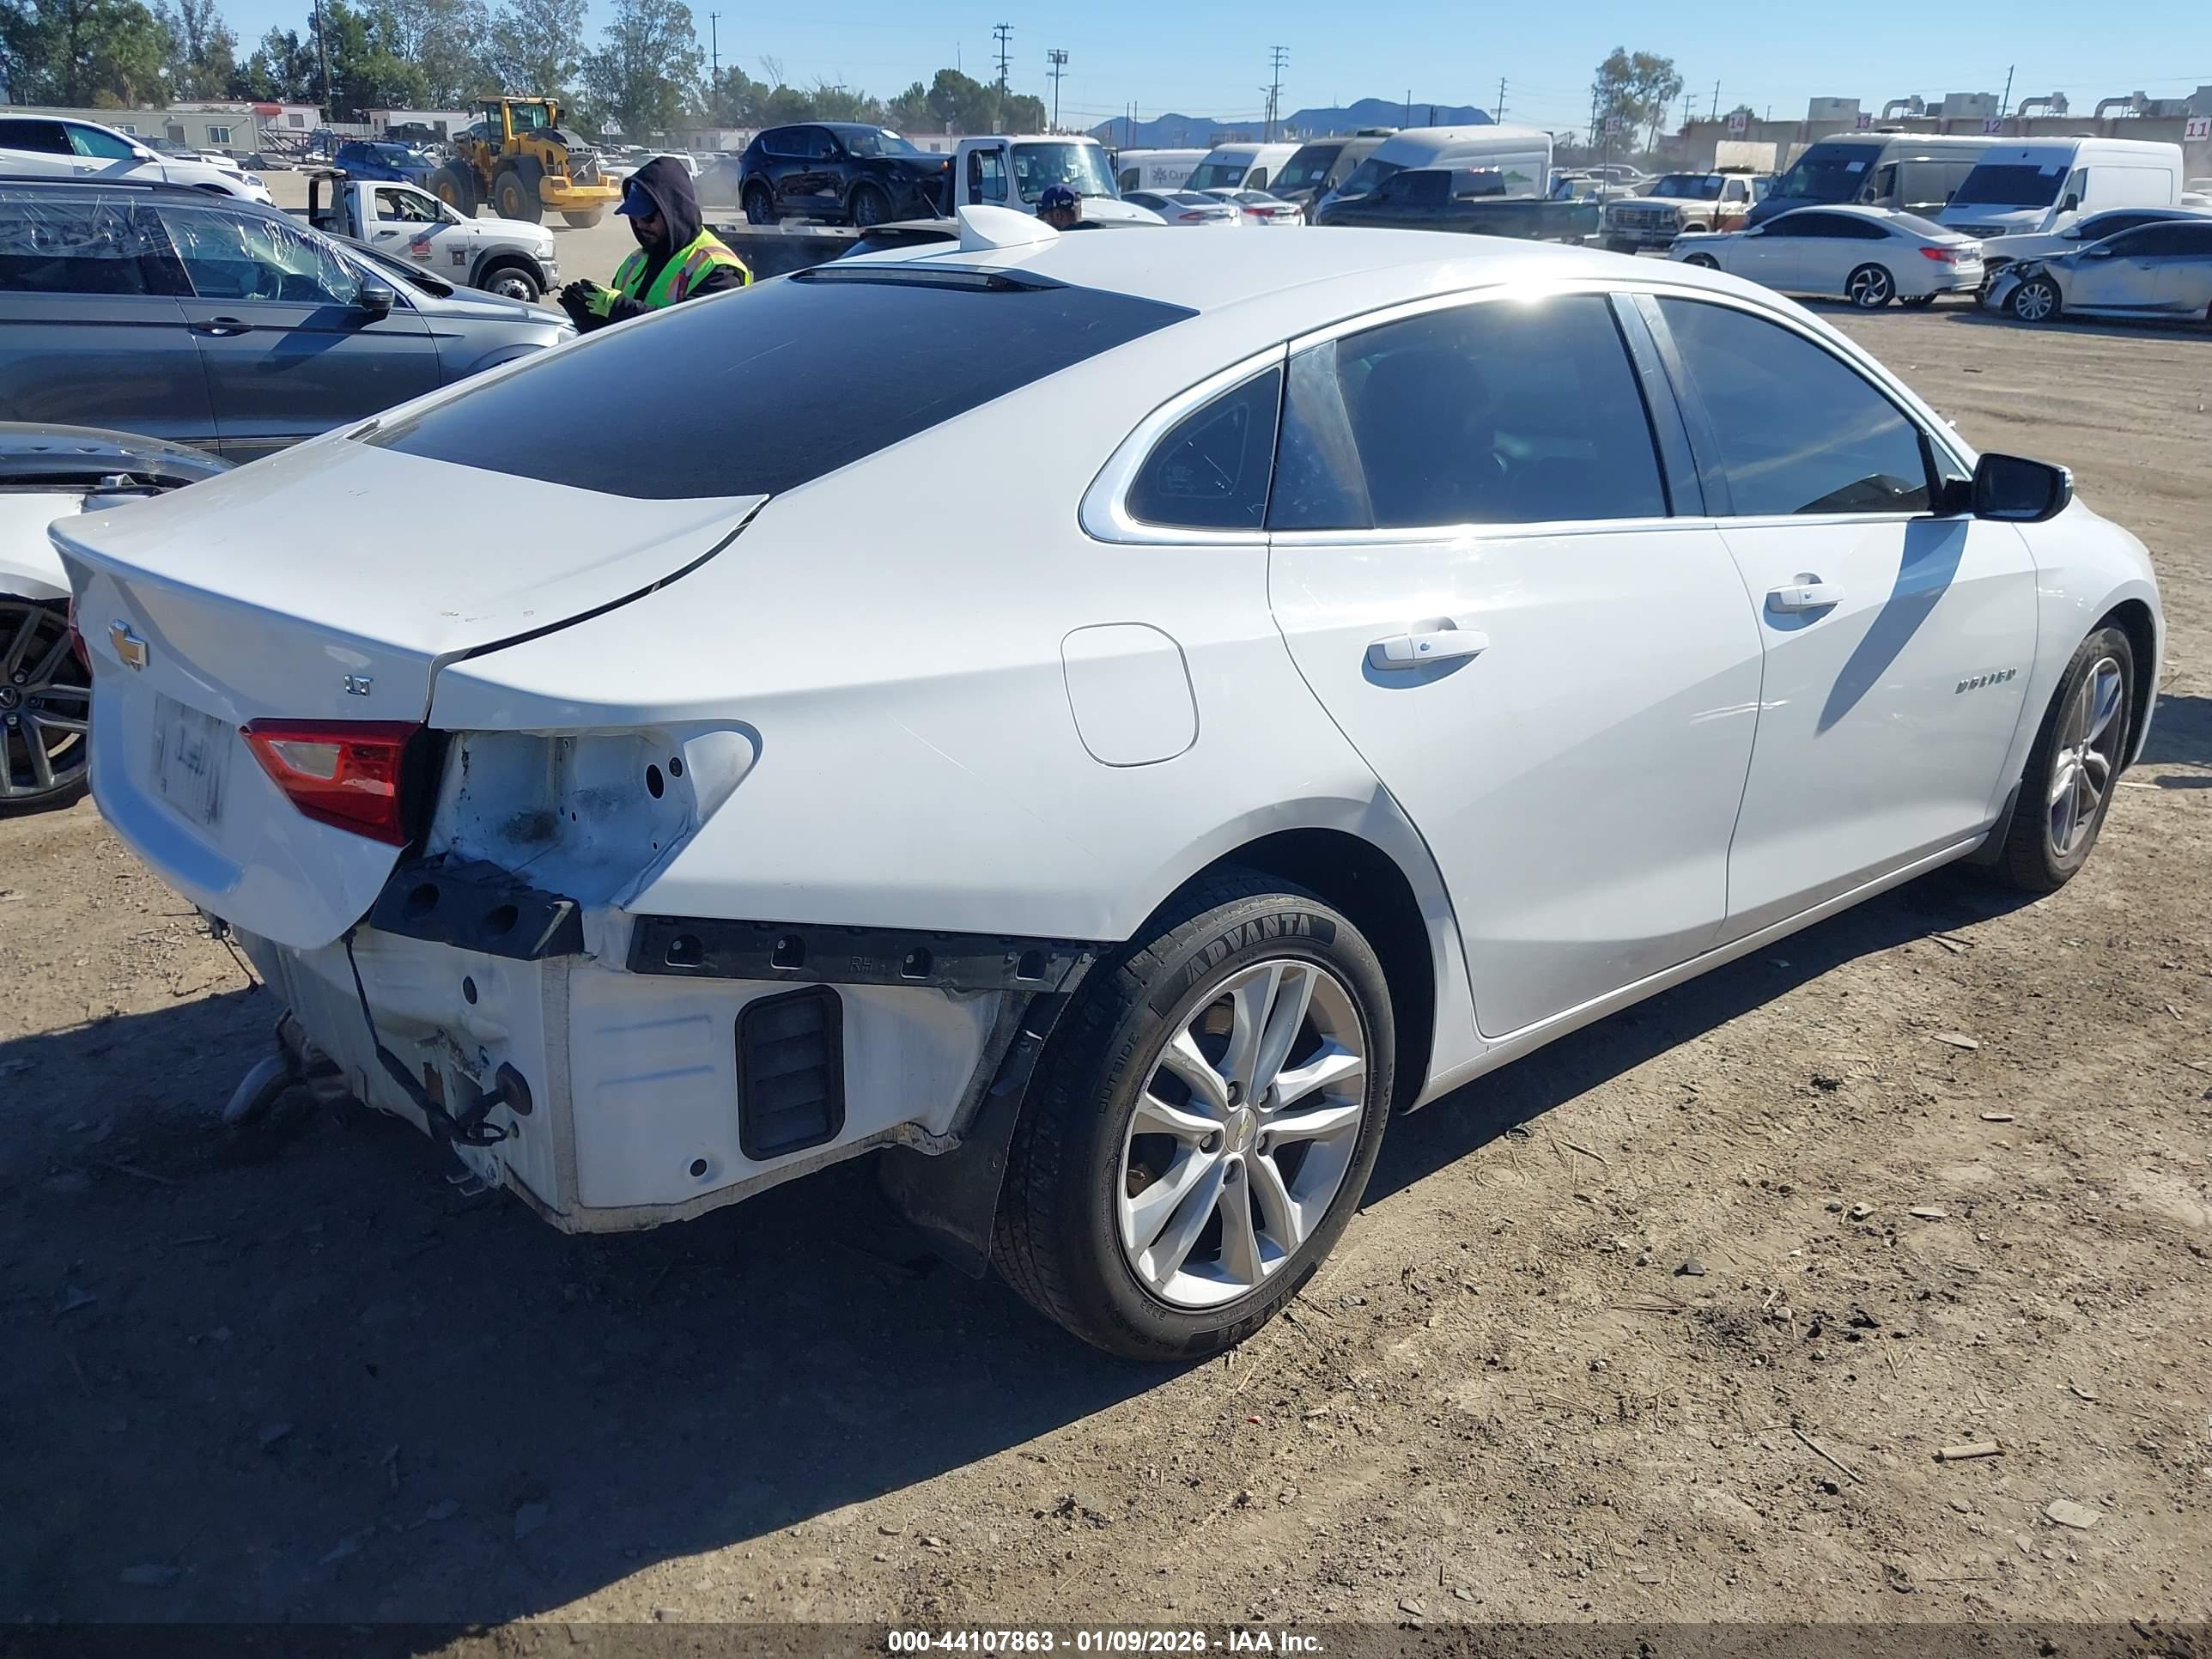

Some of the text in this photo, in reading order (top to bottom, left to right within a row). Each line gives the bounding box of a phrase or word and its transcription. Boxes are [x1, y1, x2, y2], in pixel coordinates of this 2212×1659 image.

[1607, 120, 1619, 132] 15
[1729, 118, 1744, 129] 14
[1856, 117, 1870, 129] 13
[1983, 118, 2001, 133] 12
[2186, 123, 2208, 137] 11
[1185, 913, 1311, 986] ADVANTA
[1097, 1034, 1140, 1115] OUTSIDE
